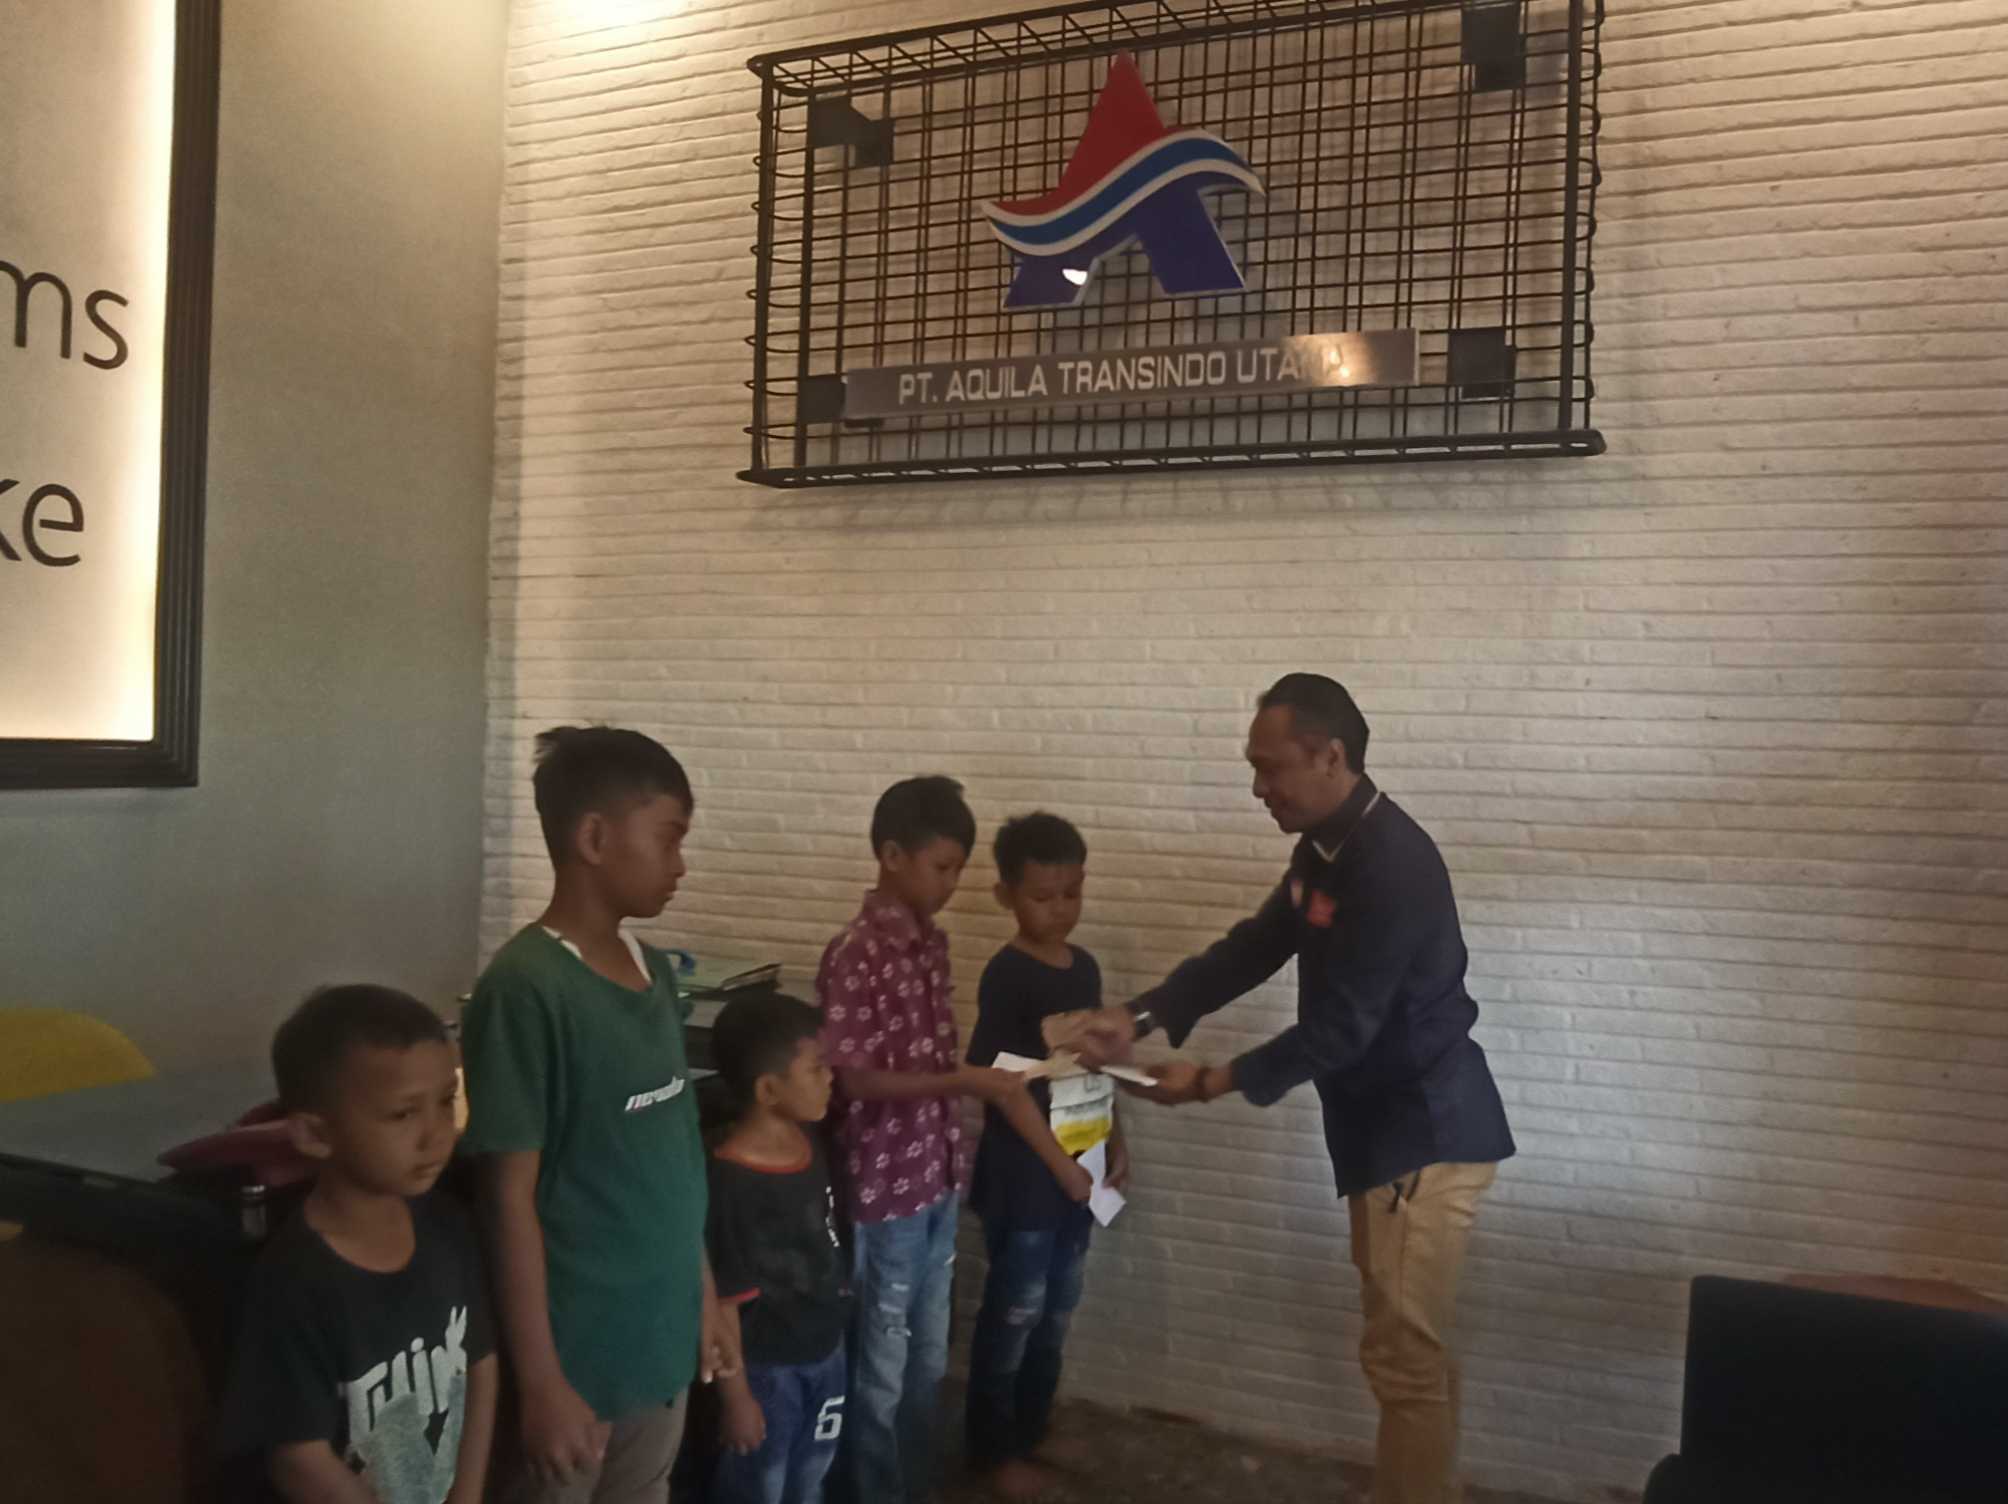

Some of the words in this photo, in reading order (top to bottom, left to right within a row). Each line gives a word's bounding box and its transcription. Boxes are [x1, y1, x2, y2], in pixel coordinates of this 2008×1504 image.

[899, 371, 938, 405] PT.
[945, 363, 1049, 403] AQUILA
[1056, 351, 1226, 395] TRANSINDO
[1236, 340, 1352, 384] UTA
[813, 1395, 846, 1442] 6
